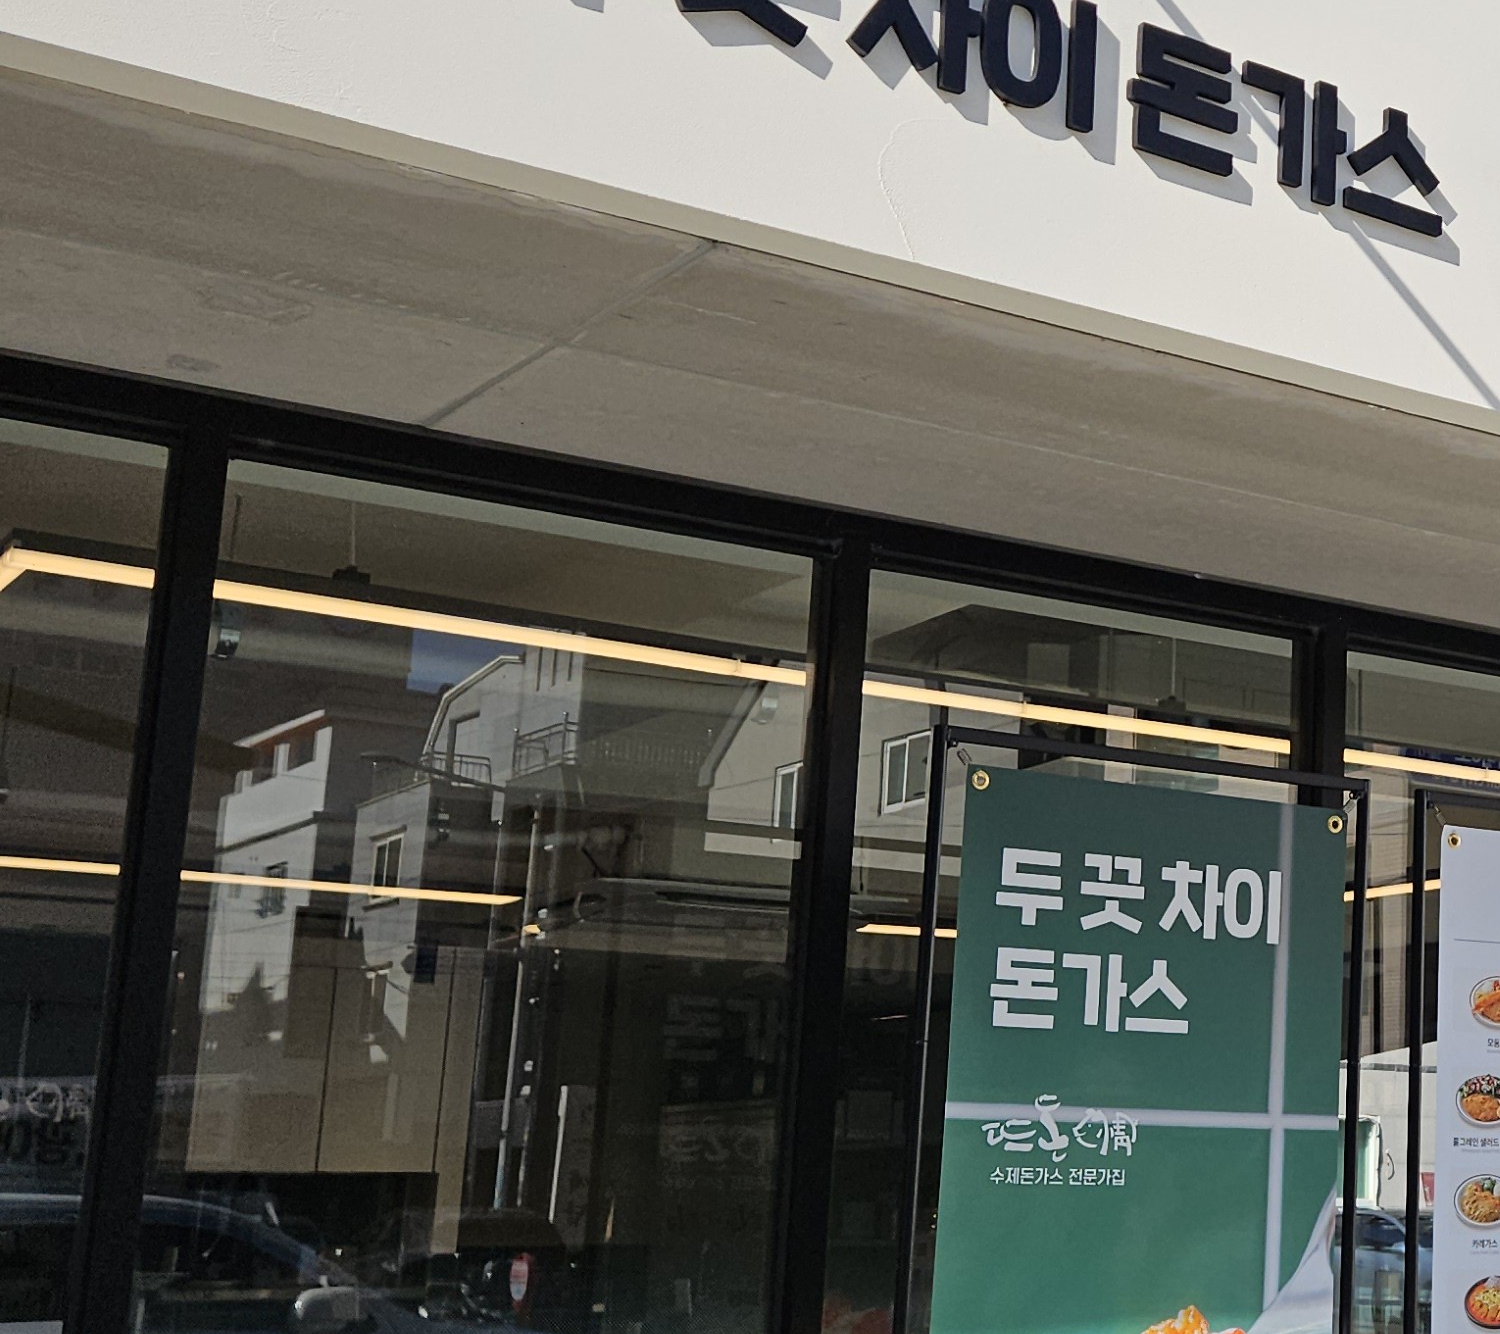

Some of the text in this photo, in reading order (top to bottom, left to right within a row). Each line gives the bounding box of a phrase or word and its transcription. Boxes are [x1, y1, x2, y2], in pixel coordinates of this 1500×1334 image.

[1126, 21, 1443, 237] 돈가스
[995, 847, 1283, 945] 두 끗 차이
[990, 946, 1189, 1034] 돈가스
[989, 1168, 1126, 1186] 수제돈가스 전문가집
